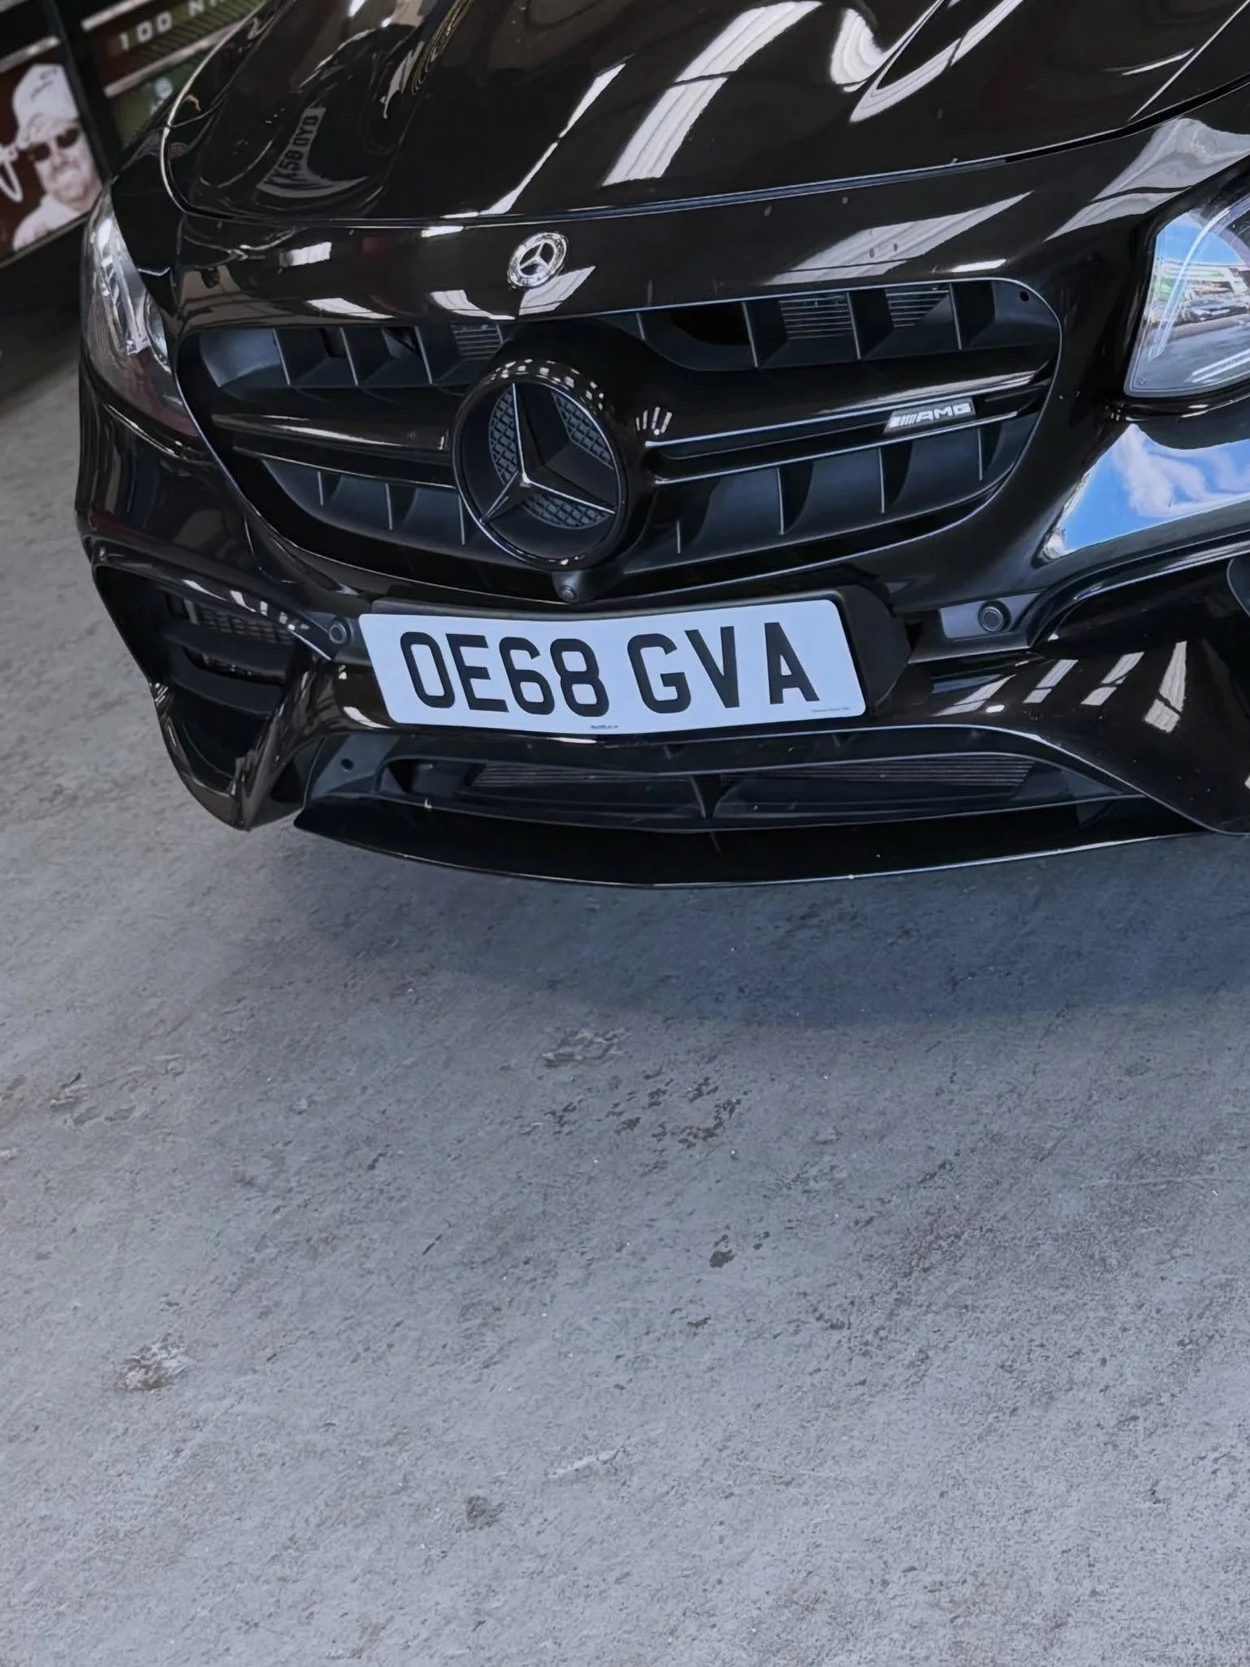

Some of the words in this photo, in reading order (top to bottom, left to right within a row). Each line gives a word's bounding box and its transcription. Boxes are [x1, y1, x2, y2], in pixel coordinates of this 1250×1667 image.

[118, 11, 173, 51] 100
[914, 402, 972, 424] AMG
[399, 630, 609, 718] OE68
[626, 621, 821, 714] GVA
